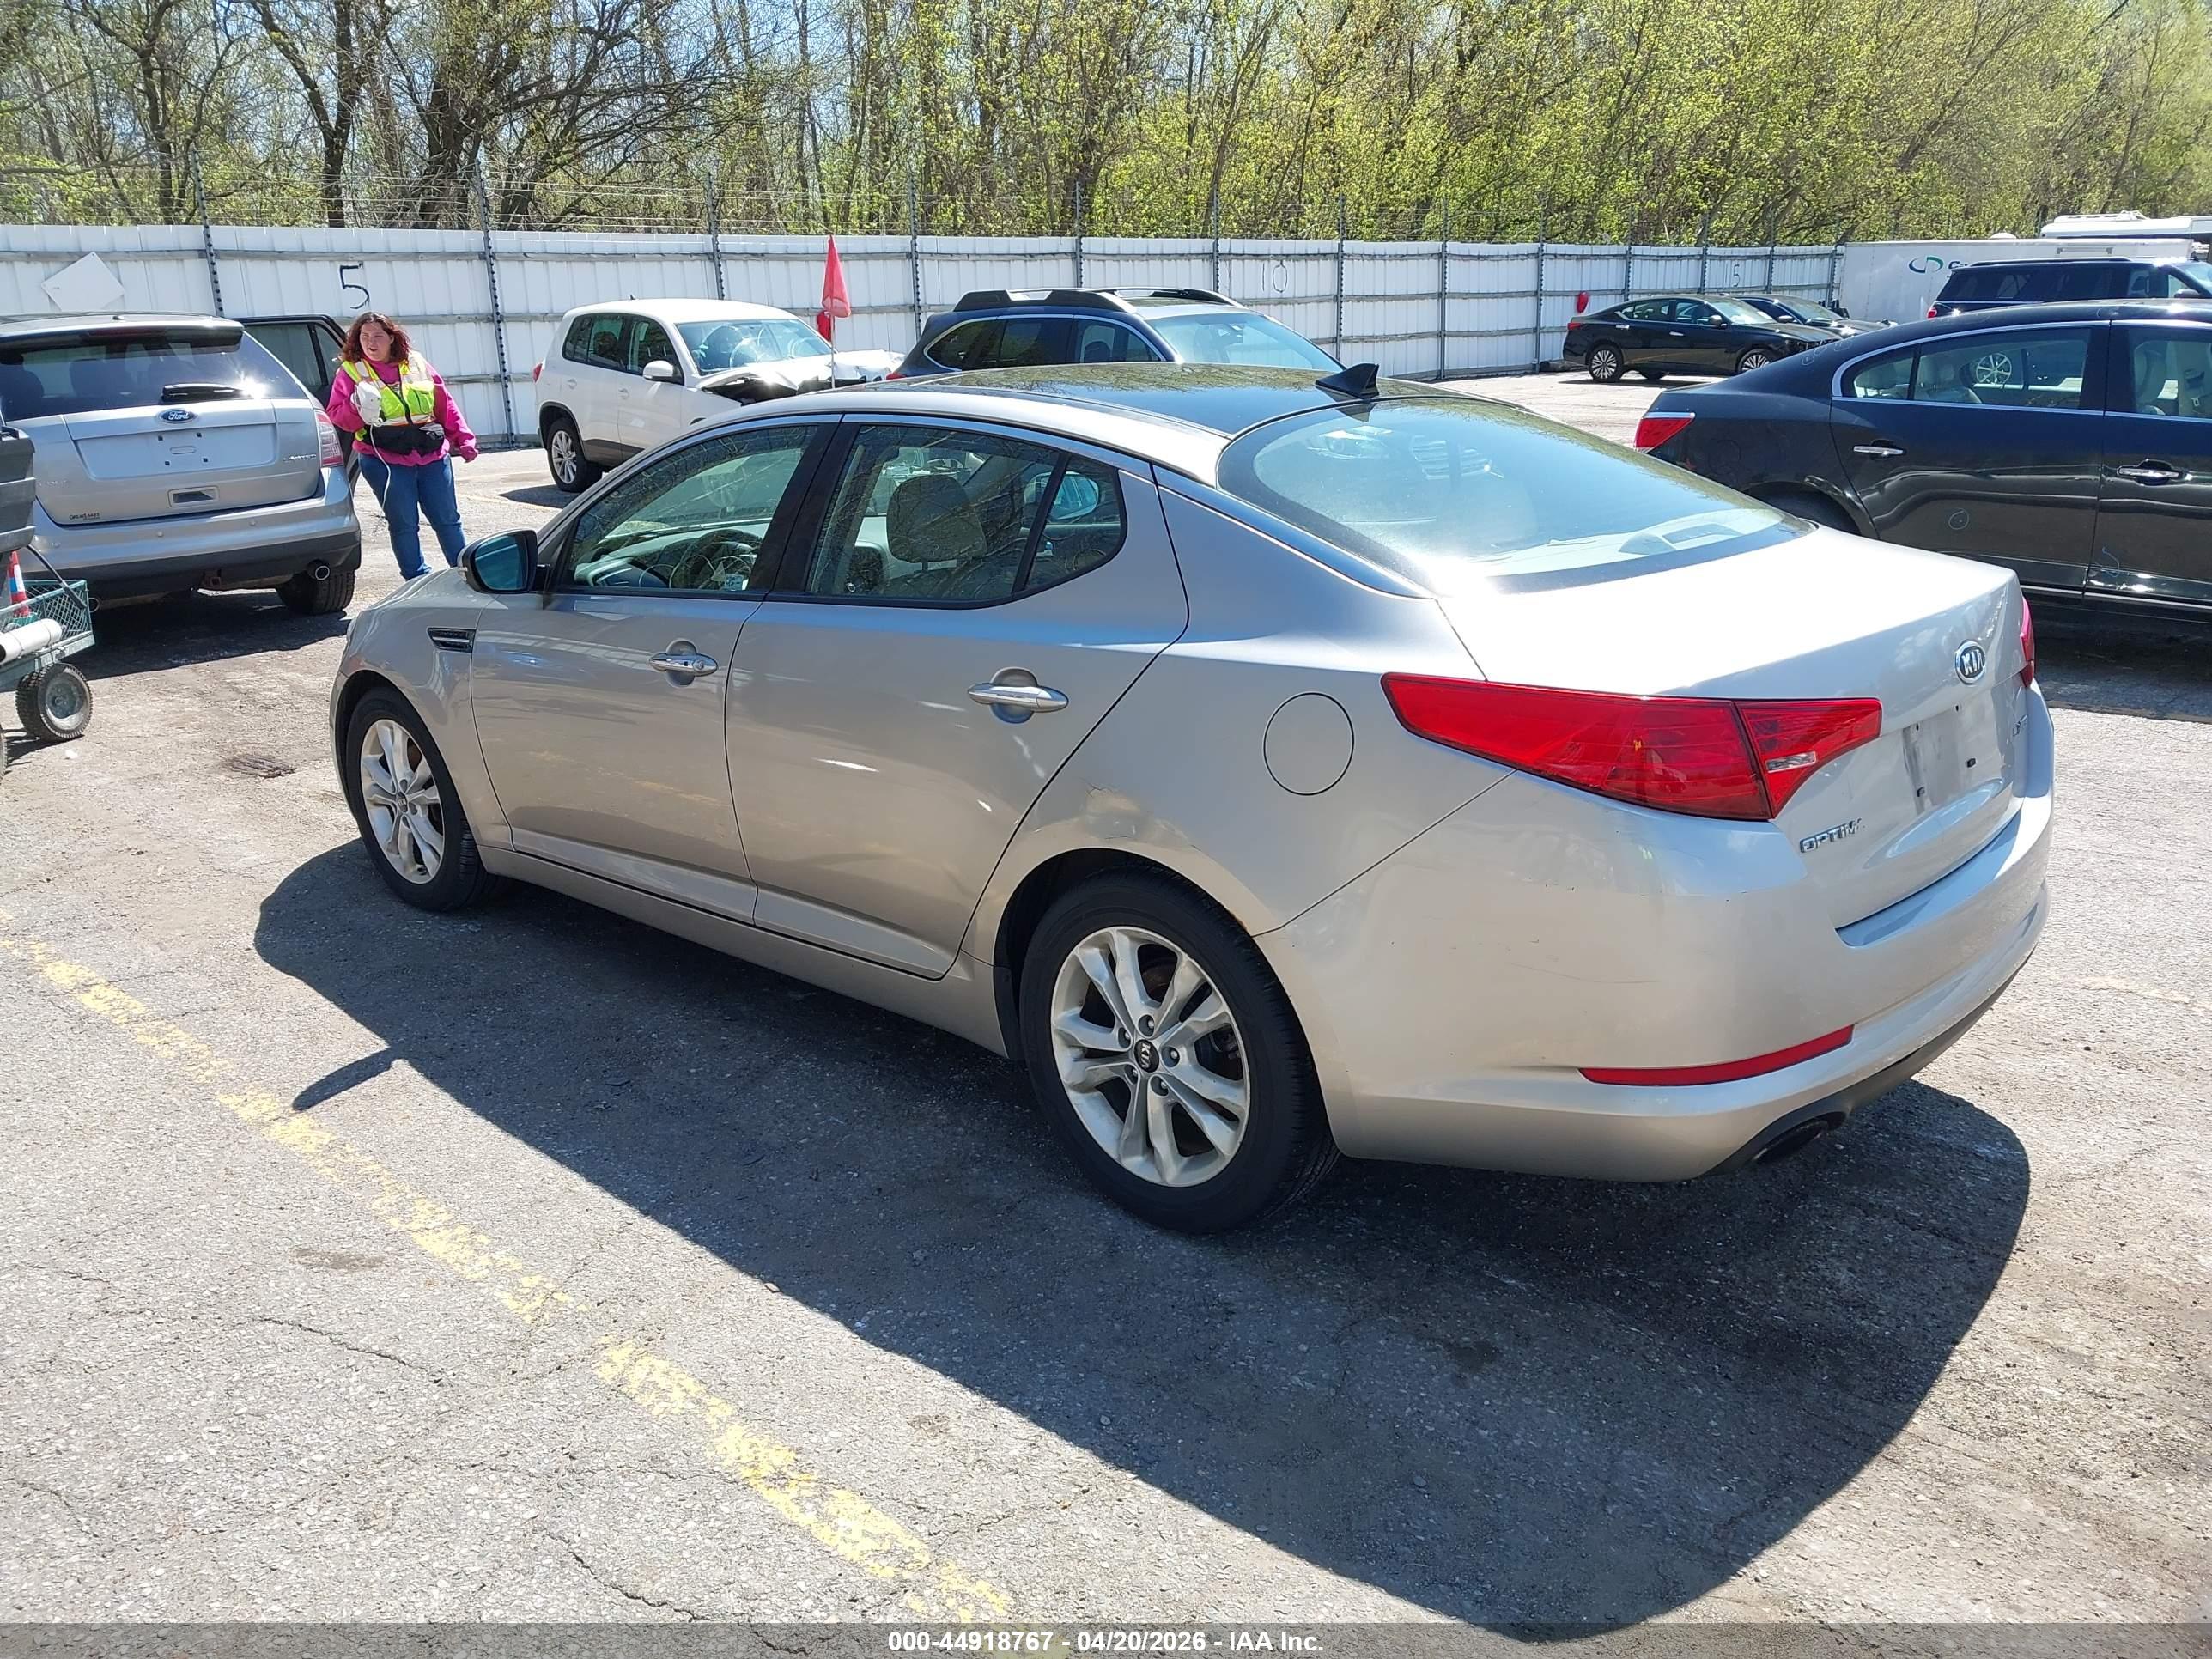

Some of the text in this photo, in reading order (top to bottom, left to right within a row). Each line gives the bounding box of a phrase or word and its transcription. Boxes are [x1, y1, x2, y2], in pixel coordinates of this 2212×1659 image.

[340, 264, 370, 309] 5
[1262, 262, 1288, 293] 10
[168, 411, 189, 420] Ford
[1961, 649, 1984, 676] KIA
[1141, 1043, 1151, 1068] KIA
